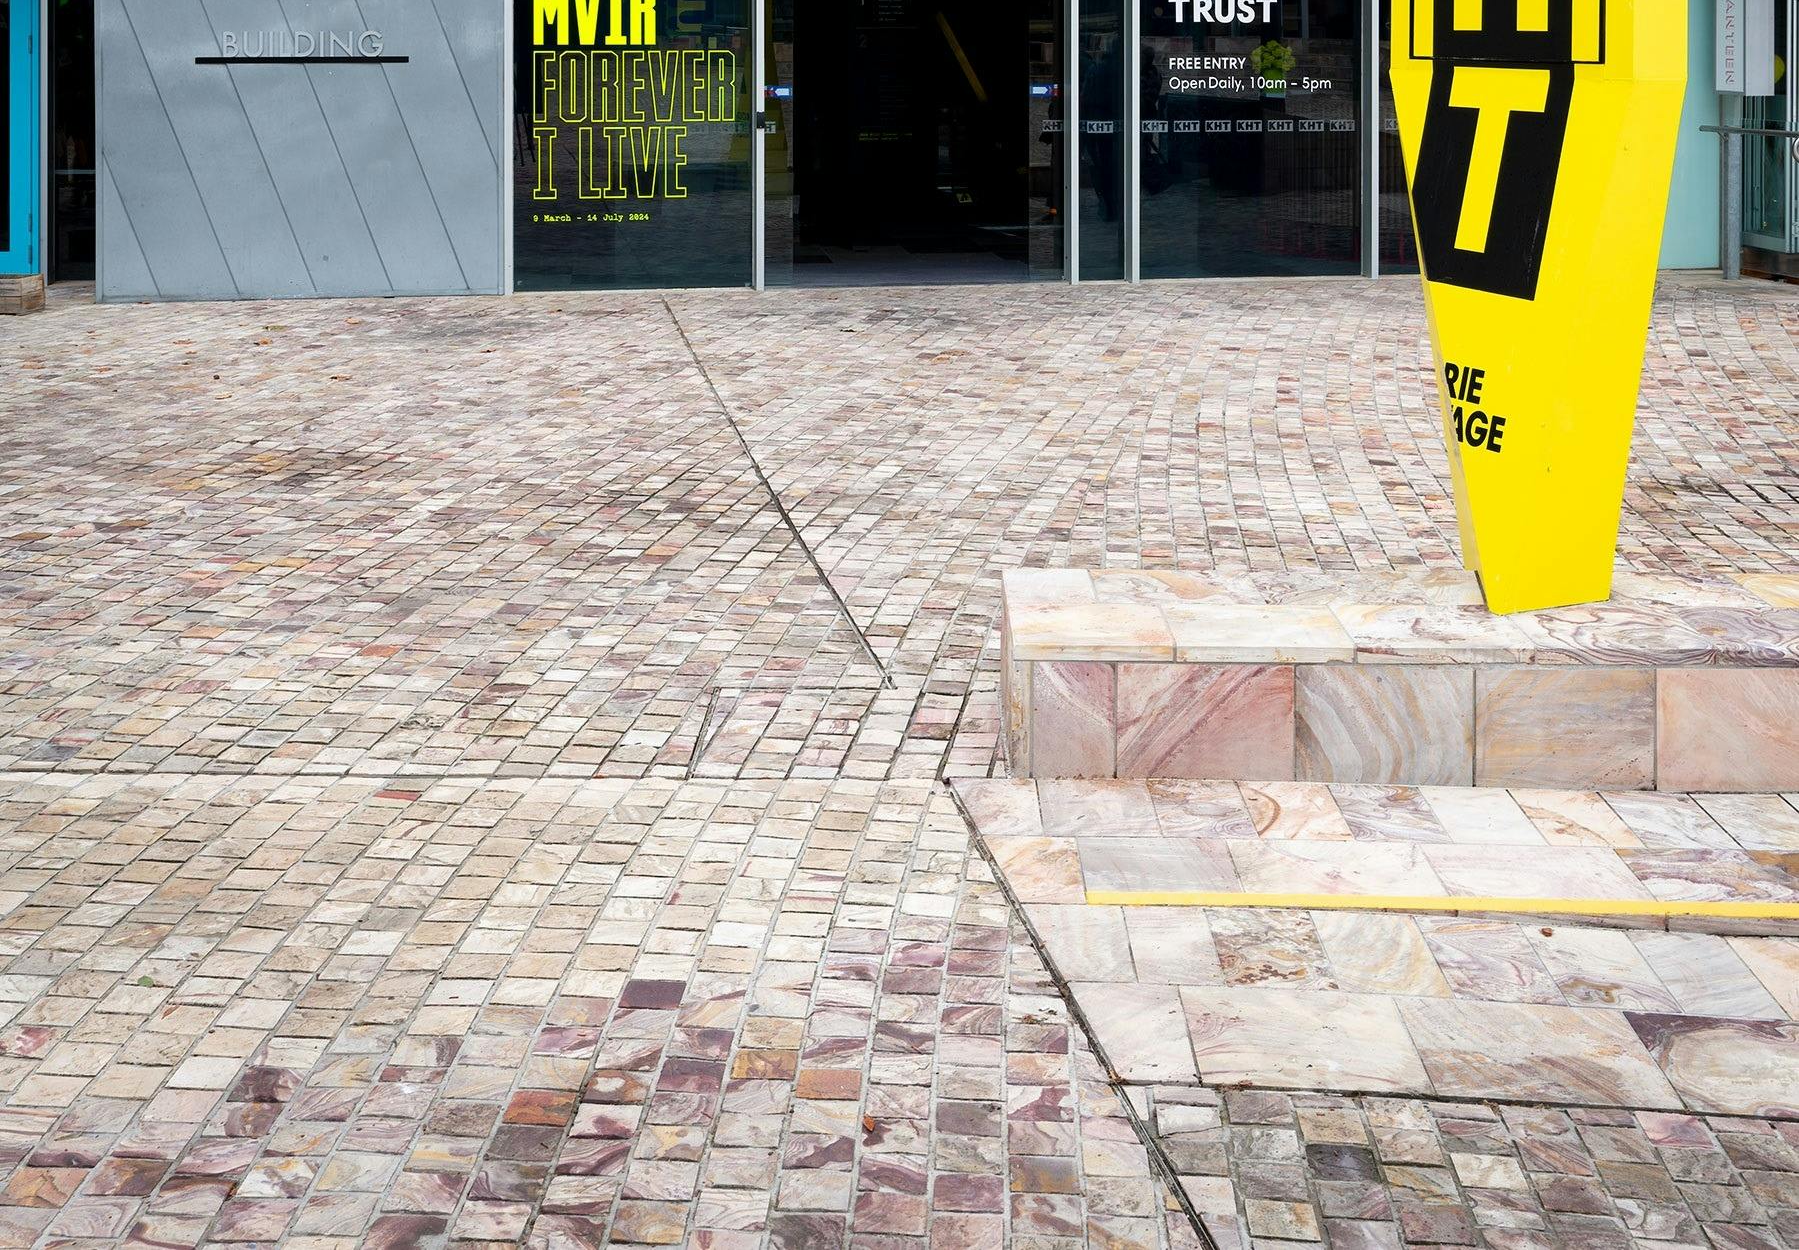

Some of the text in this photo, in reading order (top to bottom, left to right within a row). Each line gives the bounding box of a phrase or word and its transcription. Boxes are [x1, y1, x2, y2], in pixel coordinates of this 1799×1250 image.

[222, 31, 385, 57] BUILDING
[1169, 57, 1247, 70] FREE ENTRY
[533, 50, 736, 123] FOREVER
[1169, 76, 1207, 93] Open
[1208, 75, 1245, 93] Daily,
[1250, 76, 1287, 90] 10am
[1302, 76, 1332, 93] 5pm
[1087, 121, 1113, 133] KHT
[1143, 120, 1167, 132] KHT
[1174, 120, 1199, 132] KHT
[1206, 120, 1231, 132] KHT
[1237, 120, 1262, 132] KHT
[1268, 120, 1293, 132] KHT
[1299, 120, 1324, 132] KHT
[533, 126, 687, 199] I LIVE
[533, 214, 539, 222] 9
[543, 214, 571, 222] March
[587, 214, 597, 222] 14
[602, 213, 623, 223] July
[628, 213, 649, 221] 2024
[1451, 404, 1507, 453] AGE
